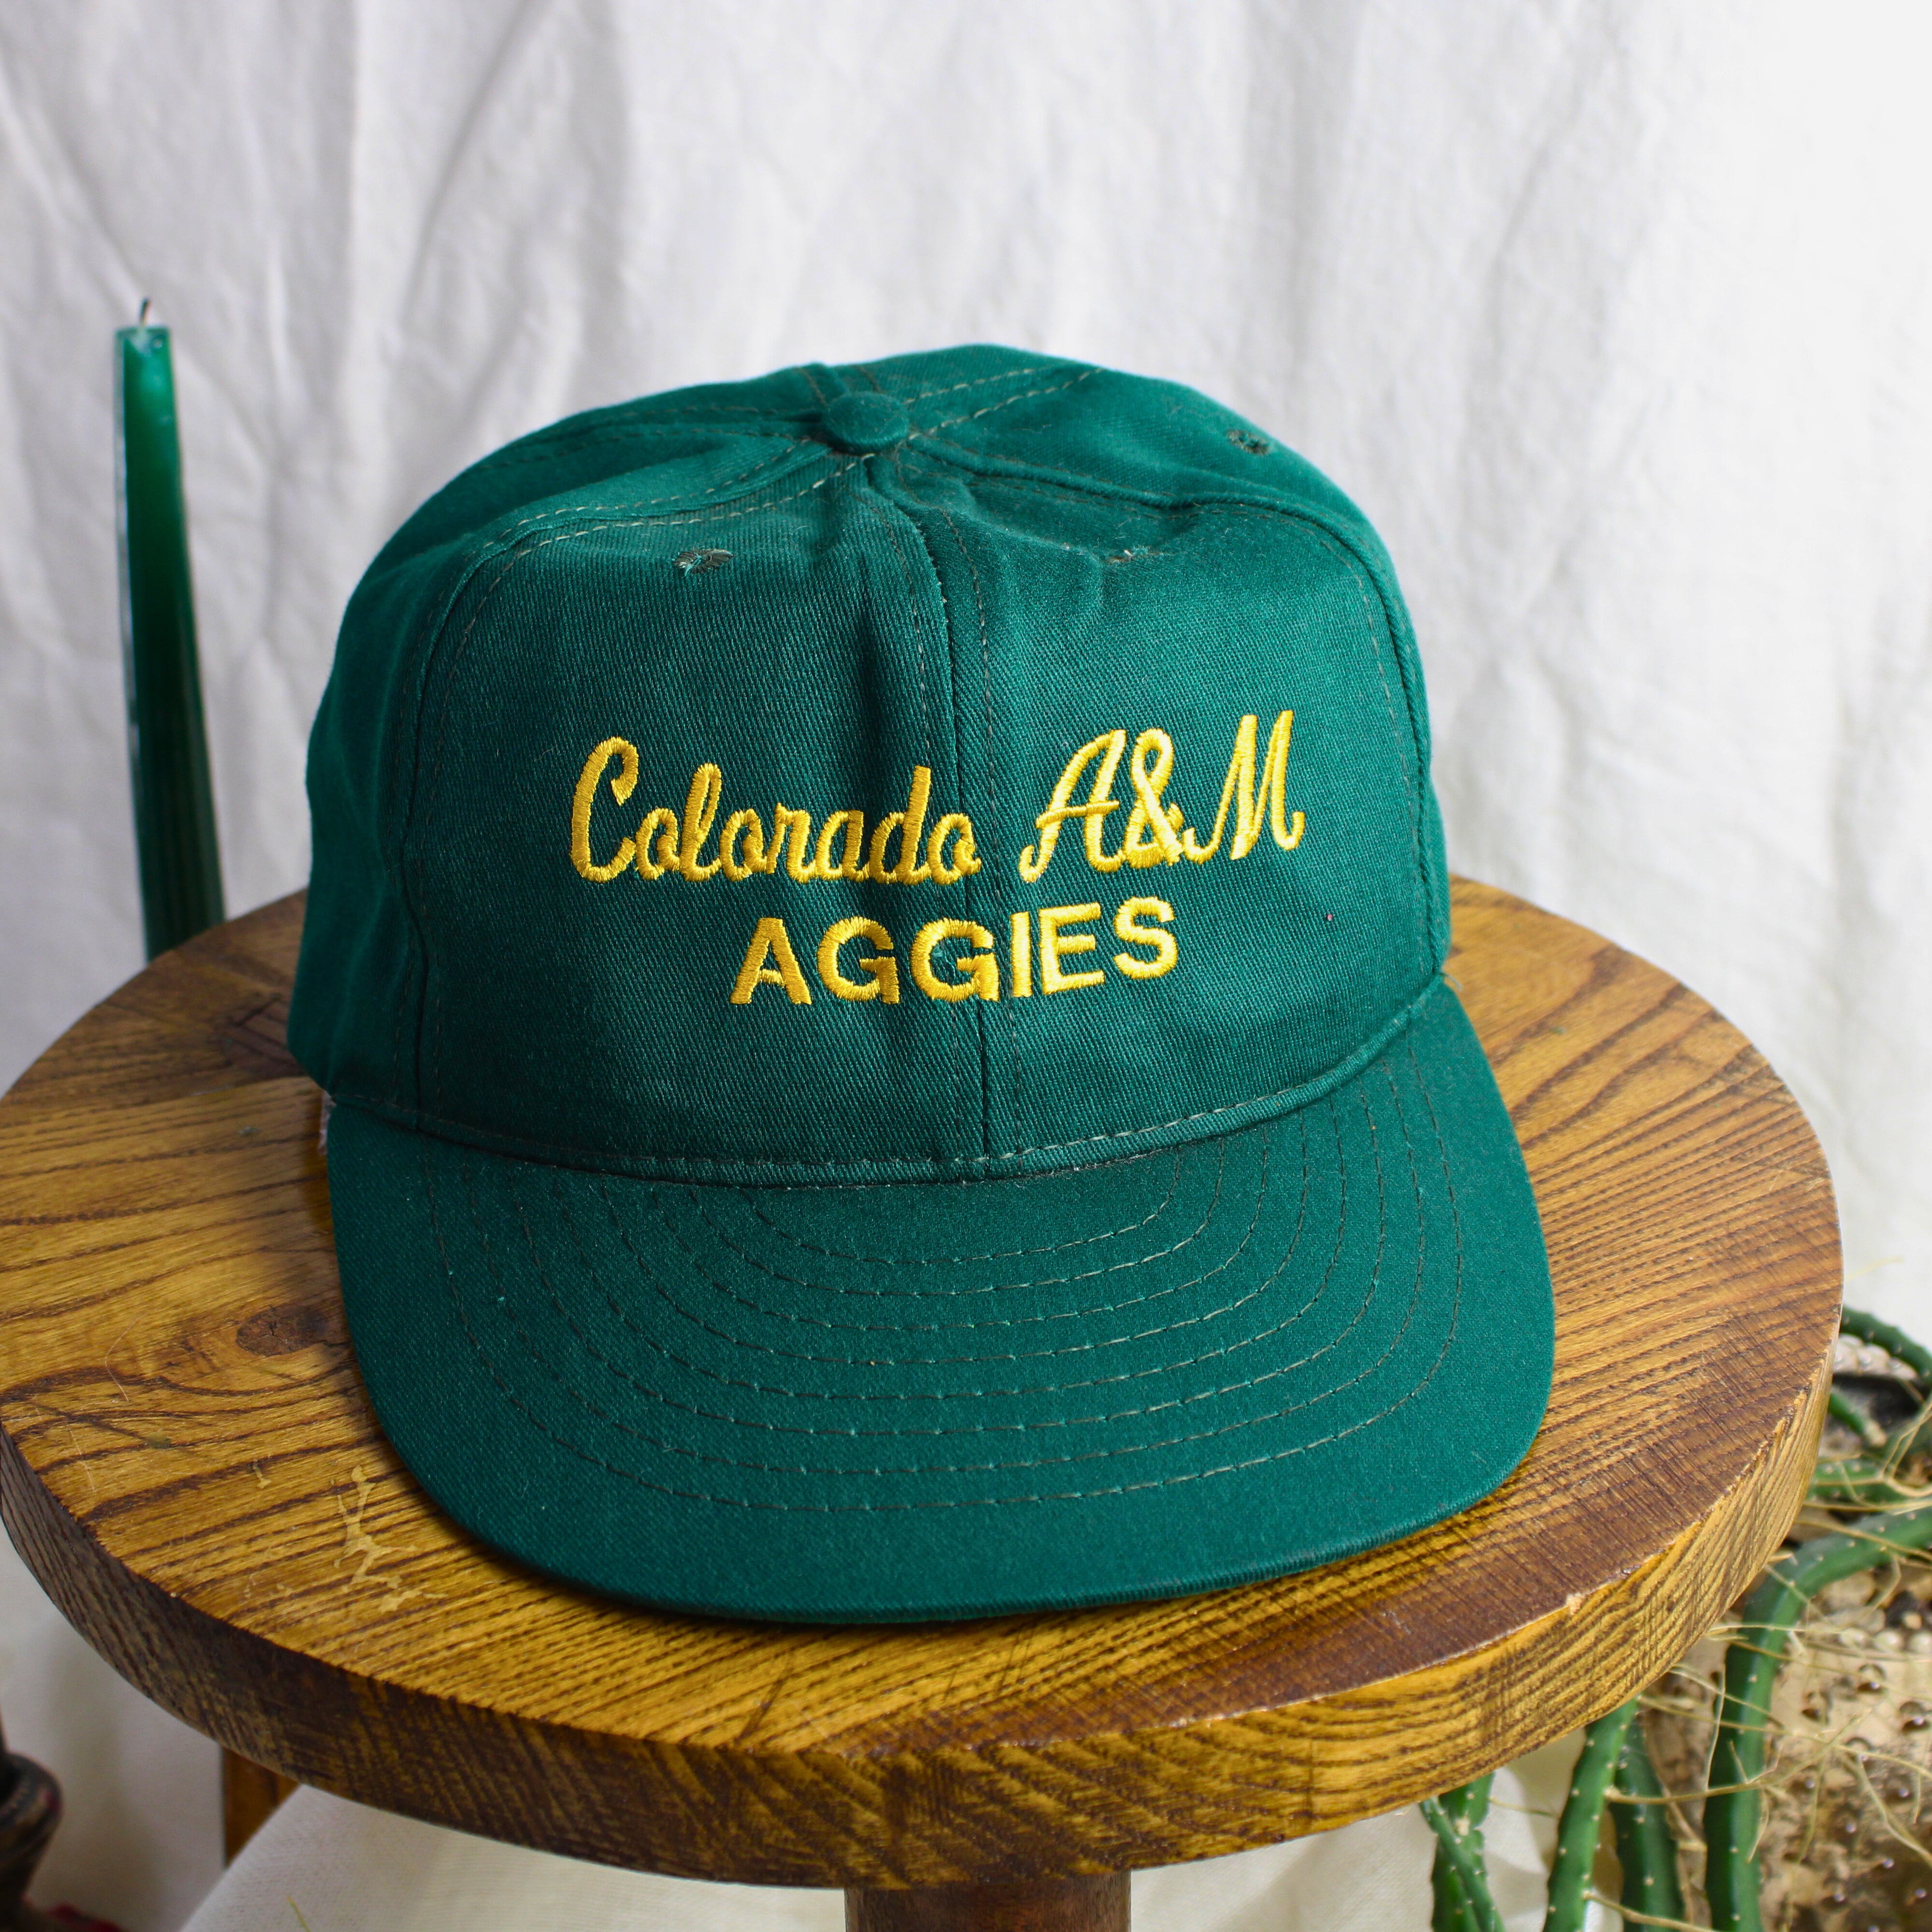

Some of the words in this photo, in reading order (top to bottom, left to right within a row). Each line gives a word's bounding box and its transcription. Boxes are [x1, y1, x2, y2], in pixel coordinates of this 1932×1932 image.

[570, 736, 982, 885] Colorado
[1018, 709, 1306, 883] A&M
[730, 896, 1178, 1005] AGGIES
